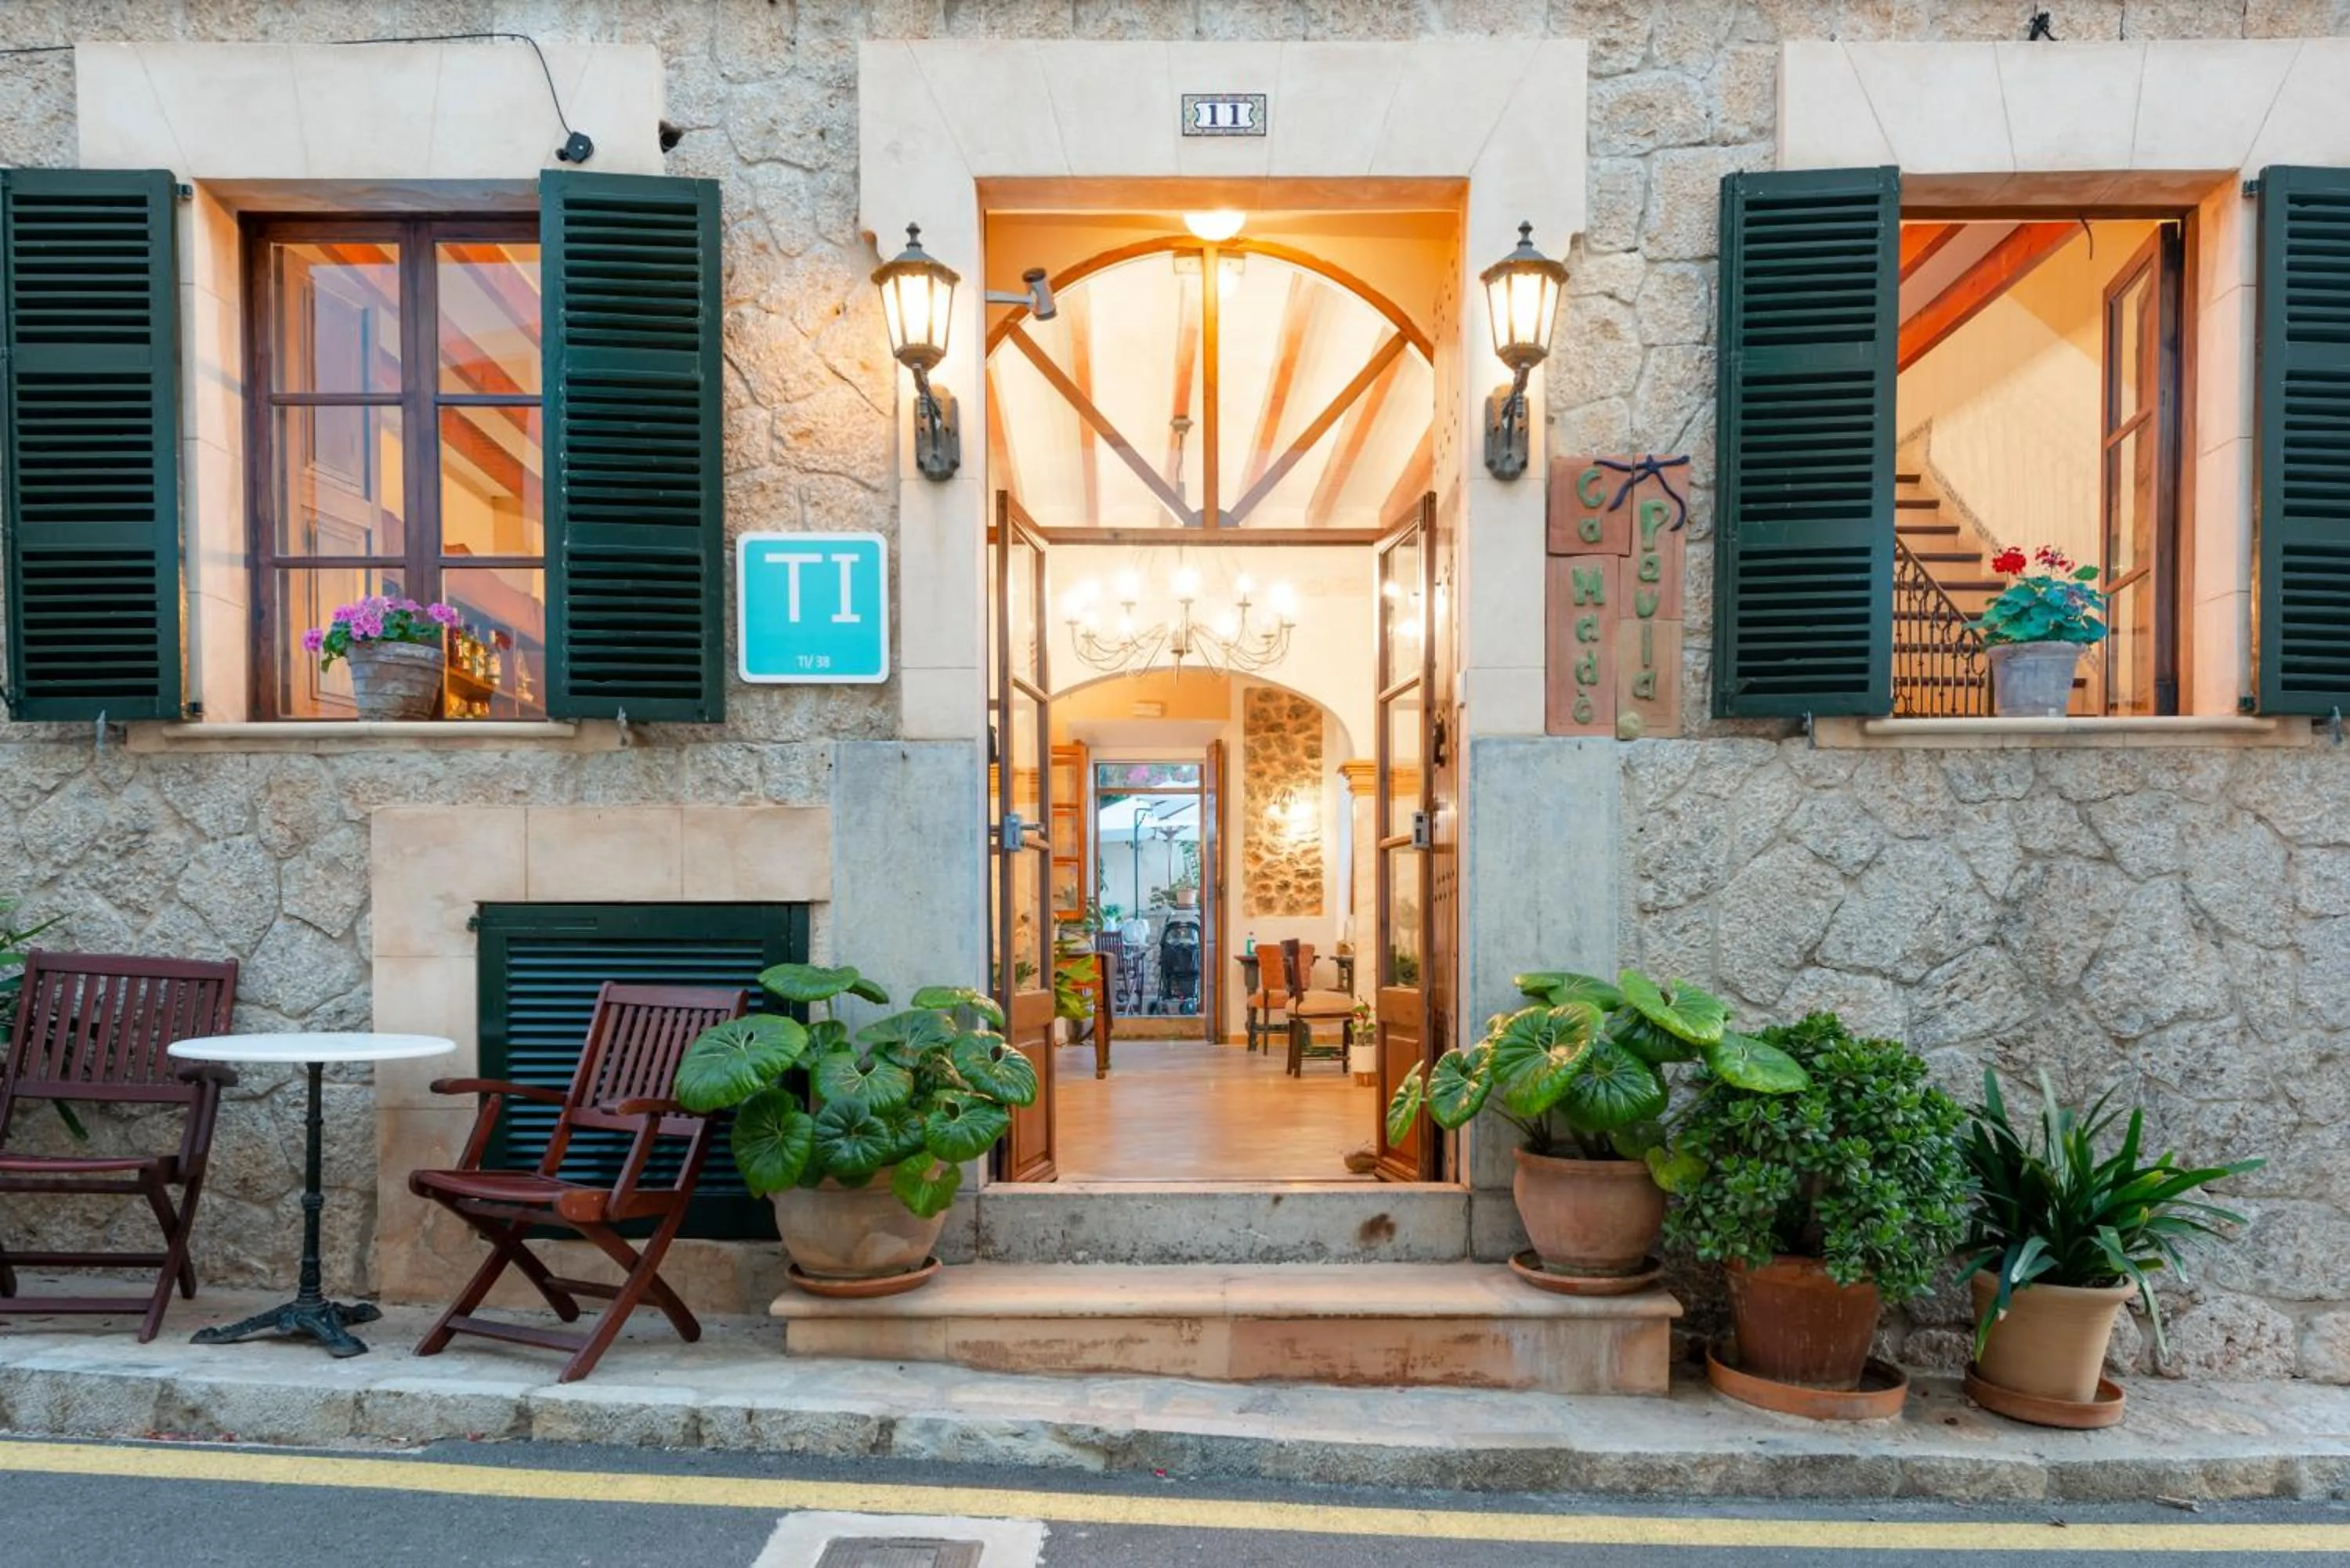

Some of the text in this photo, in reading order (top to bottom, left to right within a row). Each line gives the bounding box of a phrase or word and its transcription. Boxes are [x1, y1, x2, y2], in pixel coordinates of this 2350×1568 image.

[1209, 104, 1238, 125] 11
[1576, 468, 1607, 544] Ca
[765, 552, 861, 623] TI
[1632, 499, 1670, 700] Paula
